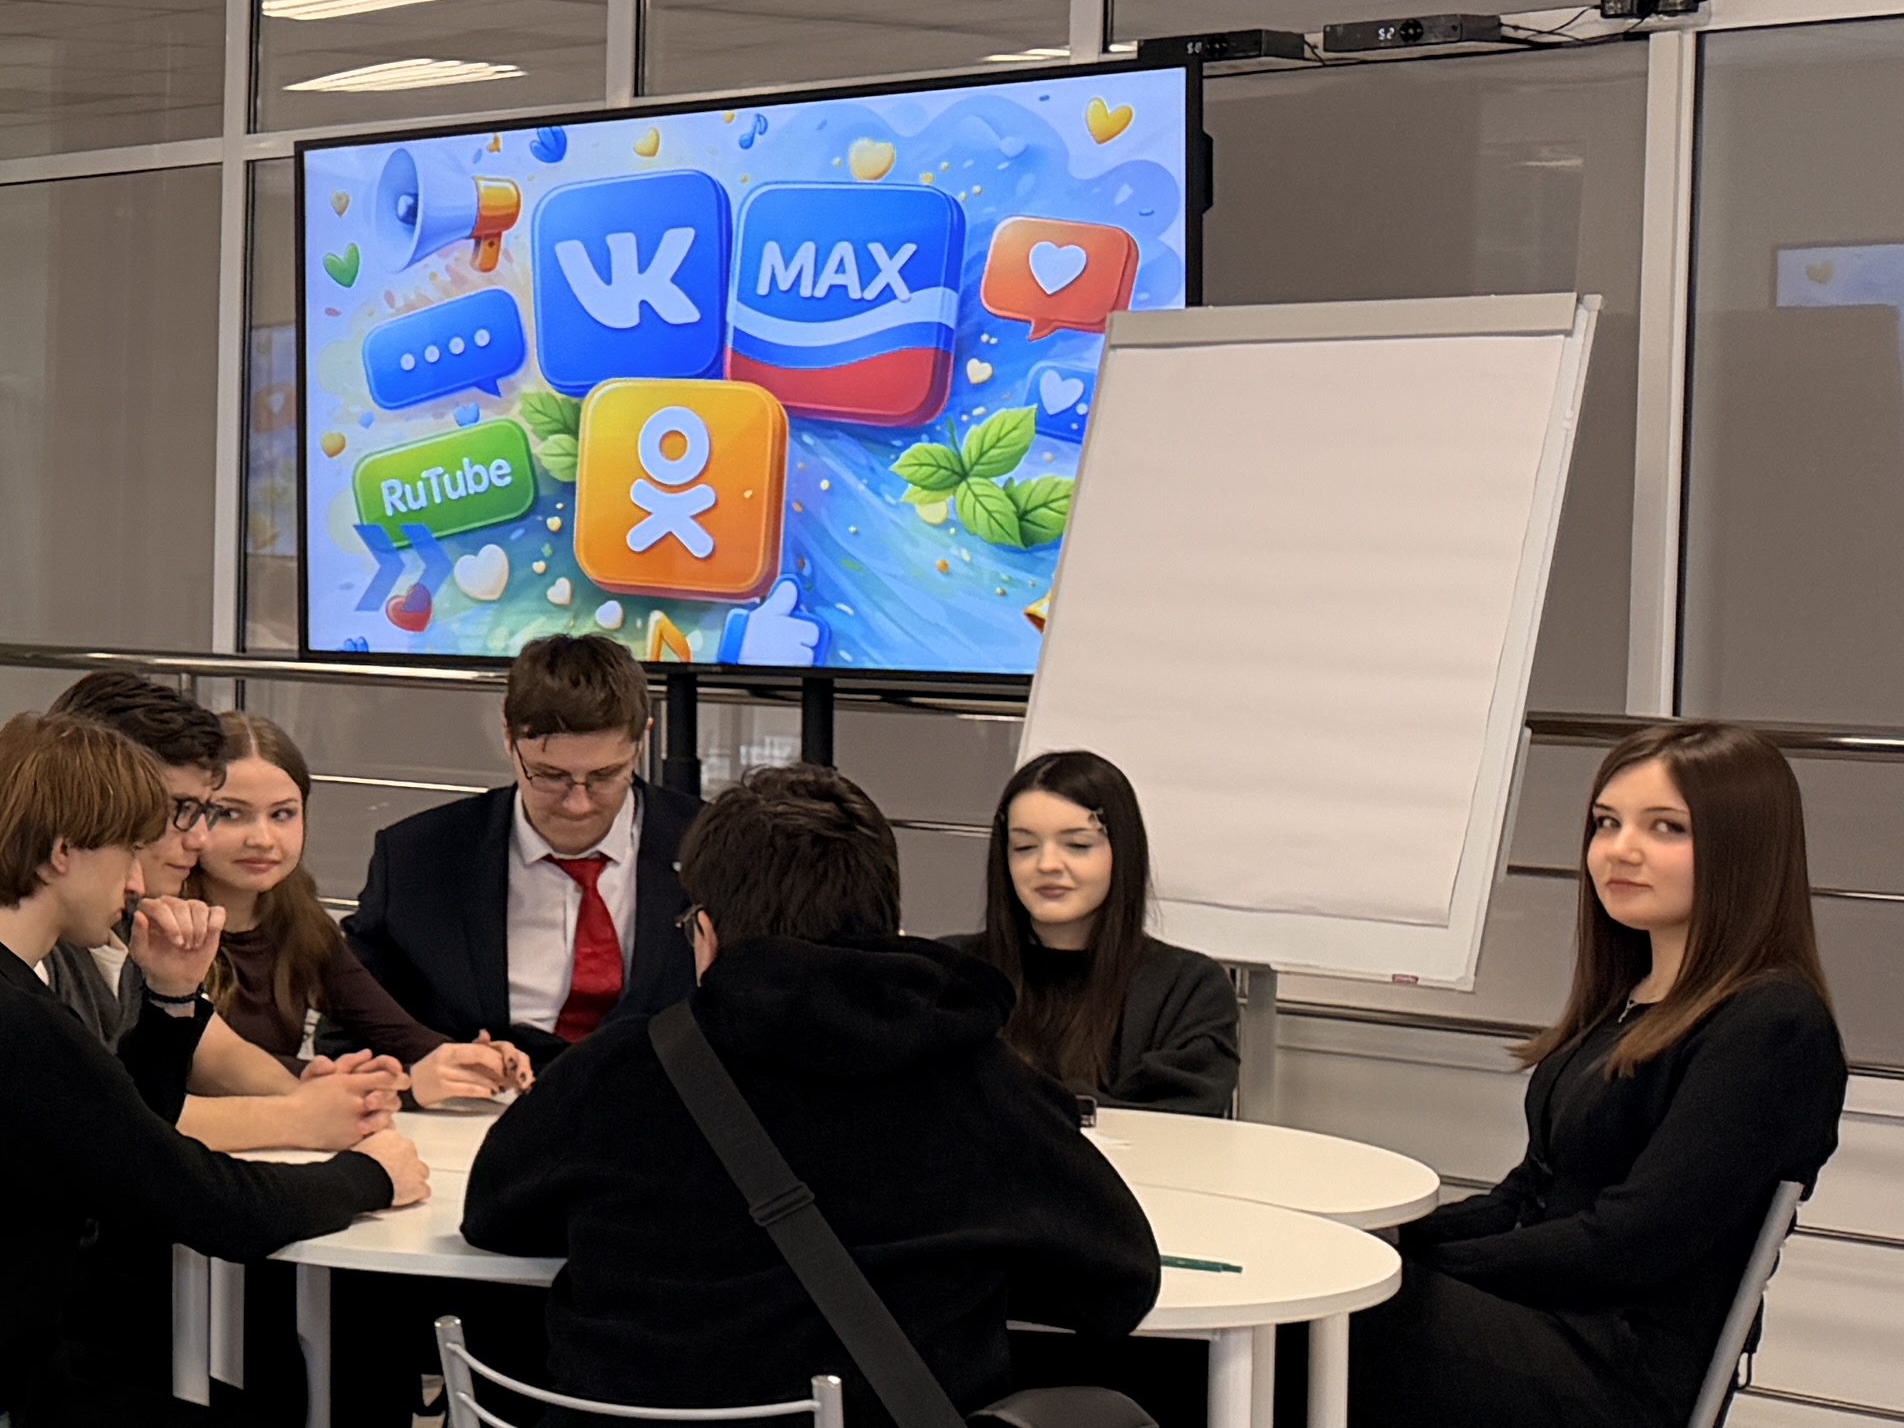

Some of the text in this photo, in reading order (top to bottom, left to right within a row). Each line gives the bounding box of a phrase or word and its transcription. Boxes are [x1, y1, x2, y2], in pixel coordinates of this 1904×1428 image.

[554, 227, 701, 329] VK
[756, 241, 917, 302] MAX
[381, 458, 512, 516] RuTube
